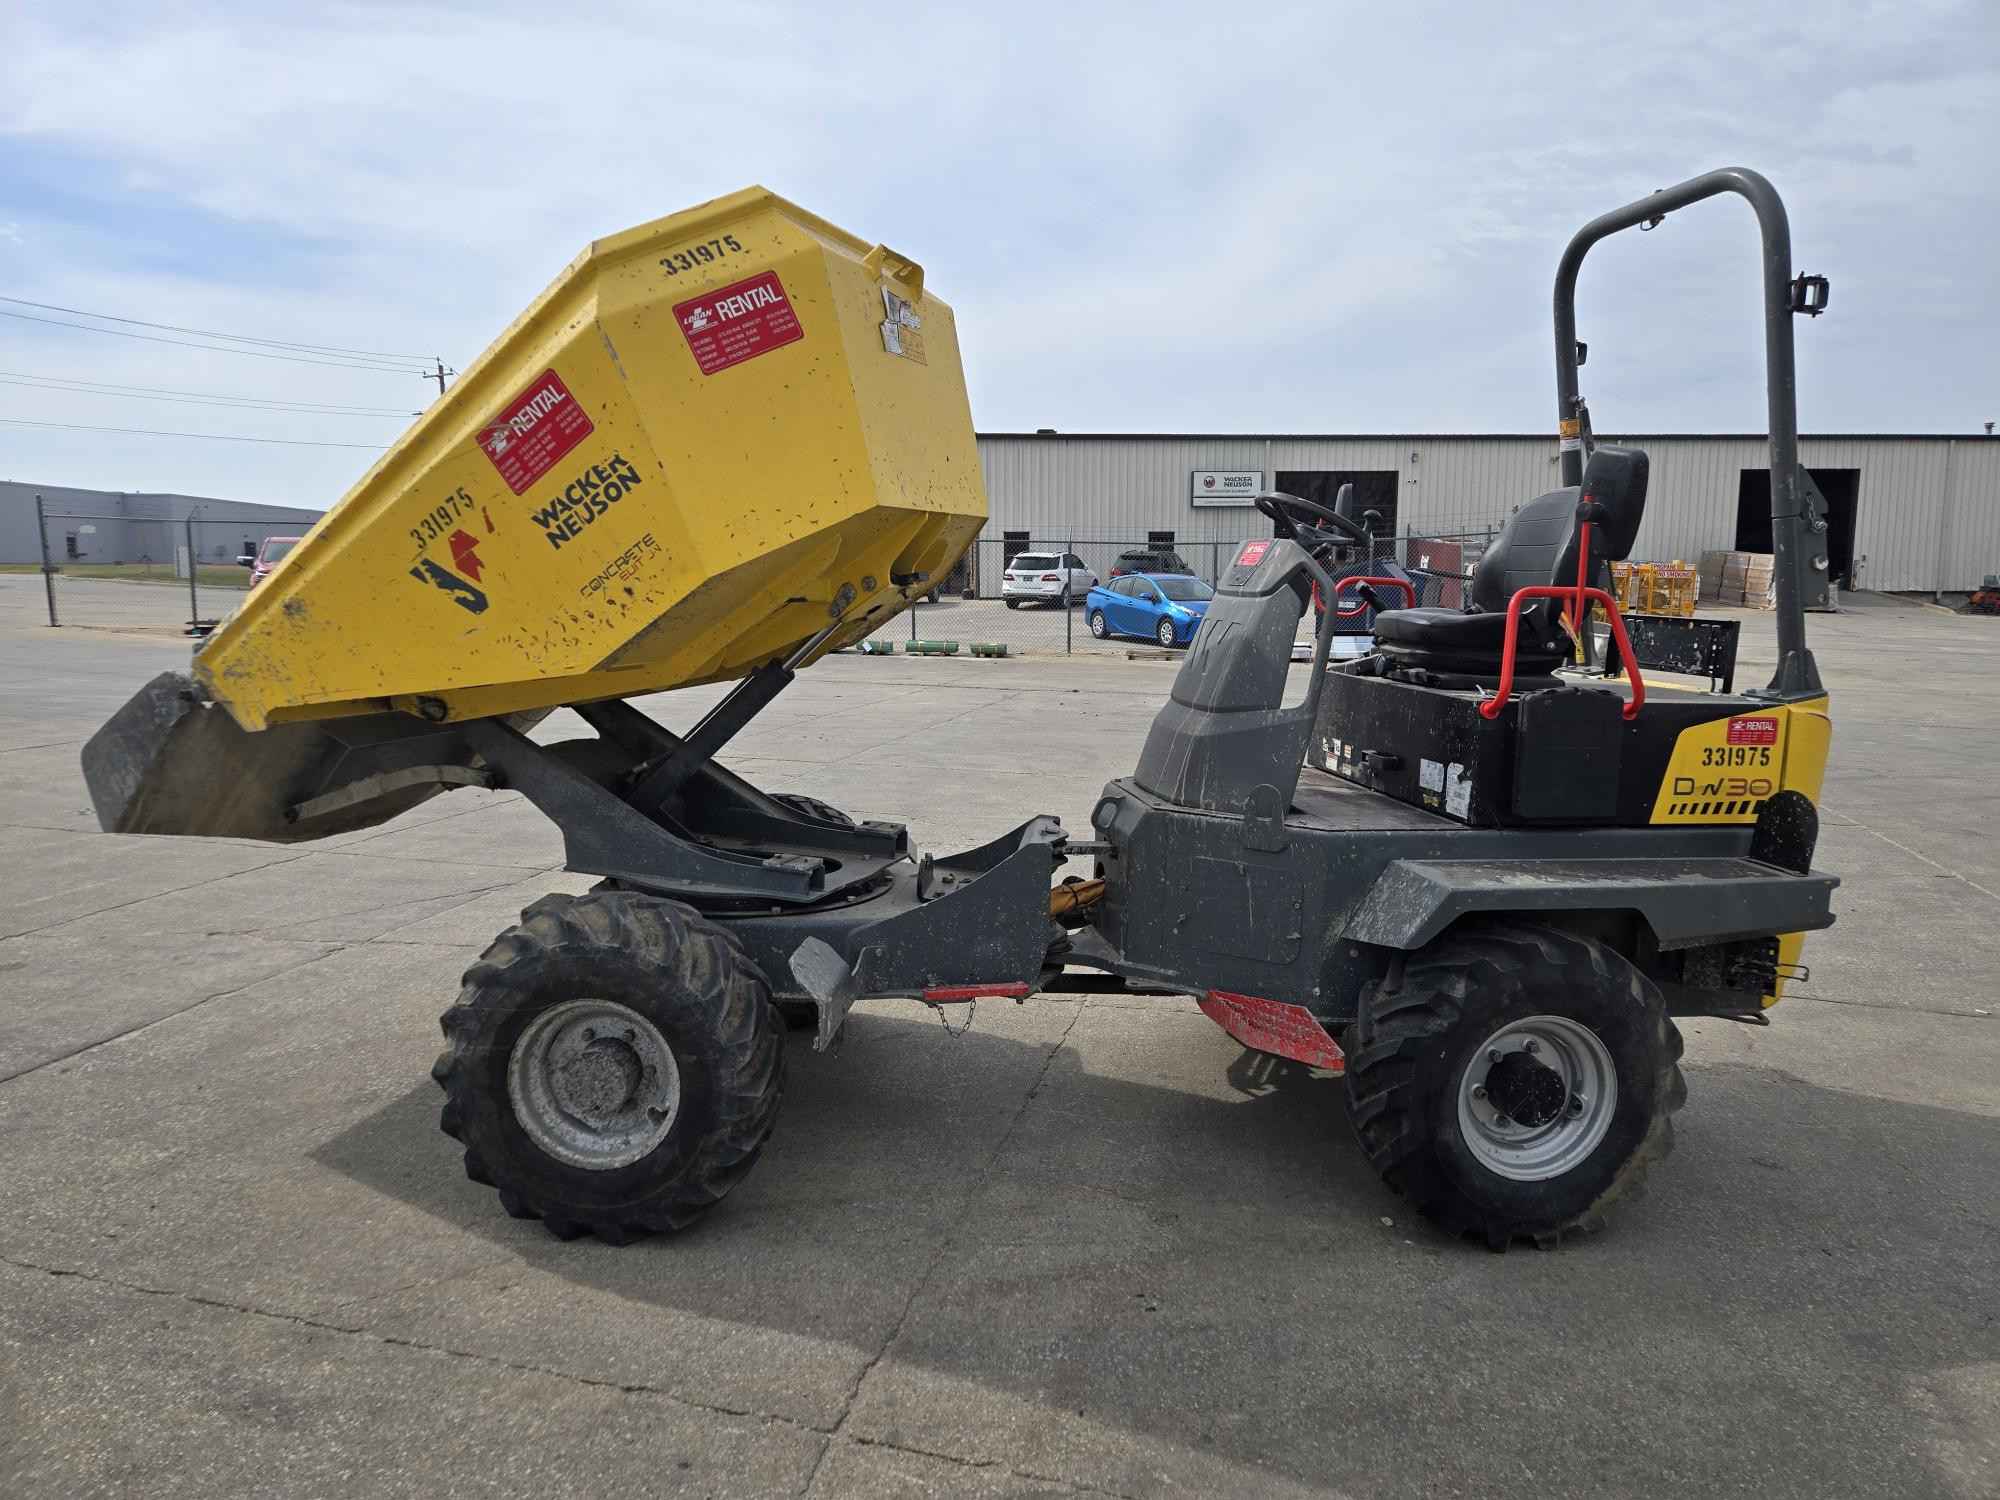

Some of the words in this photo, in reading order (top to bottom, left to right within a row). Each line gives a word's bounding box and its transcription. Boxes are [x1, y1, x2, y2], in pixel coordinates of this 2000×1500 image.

[659, 234, 742, 275] 331975
[683, 308, 713, 325] LOGAN
[715, 284, 783, 322] RENTAL
[509, 384, 567, 437] RENTAL
[410, 487, 474, 549] 331975
[546, 465, 642, 550] NEUSON
[580, 533, 656, 599] CONCRETE
[1653, 563, 1677, 571] PROPANE
[1746, 721, 1775, 731] RENTAL
[1702, 747, 1770, 767] 331975
